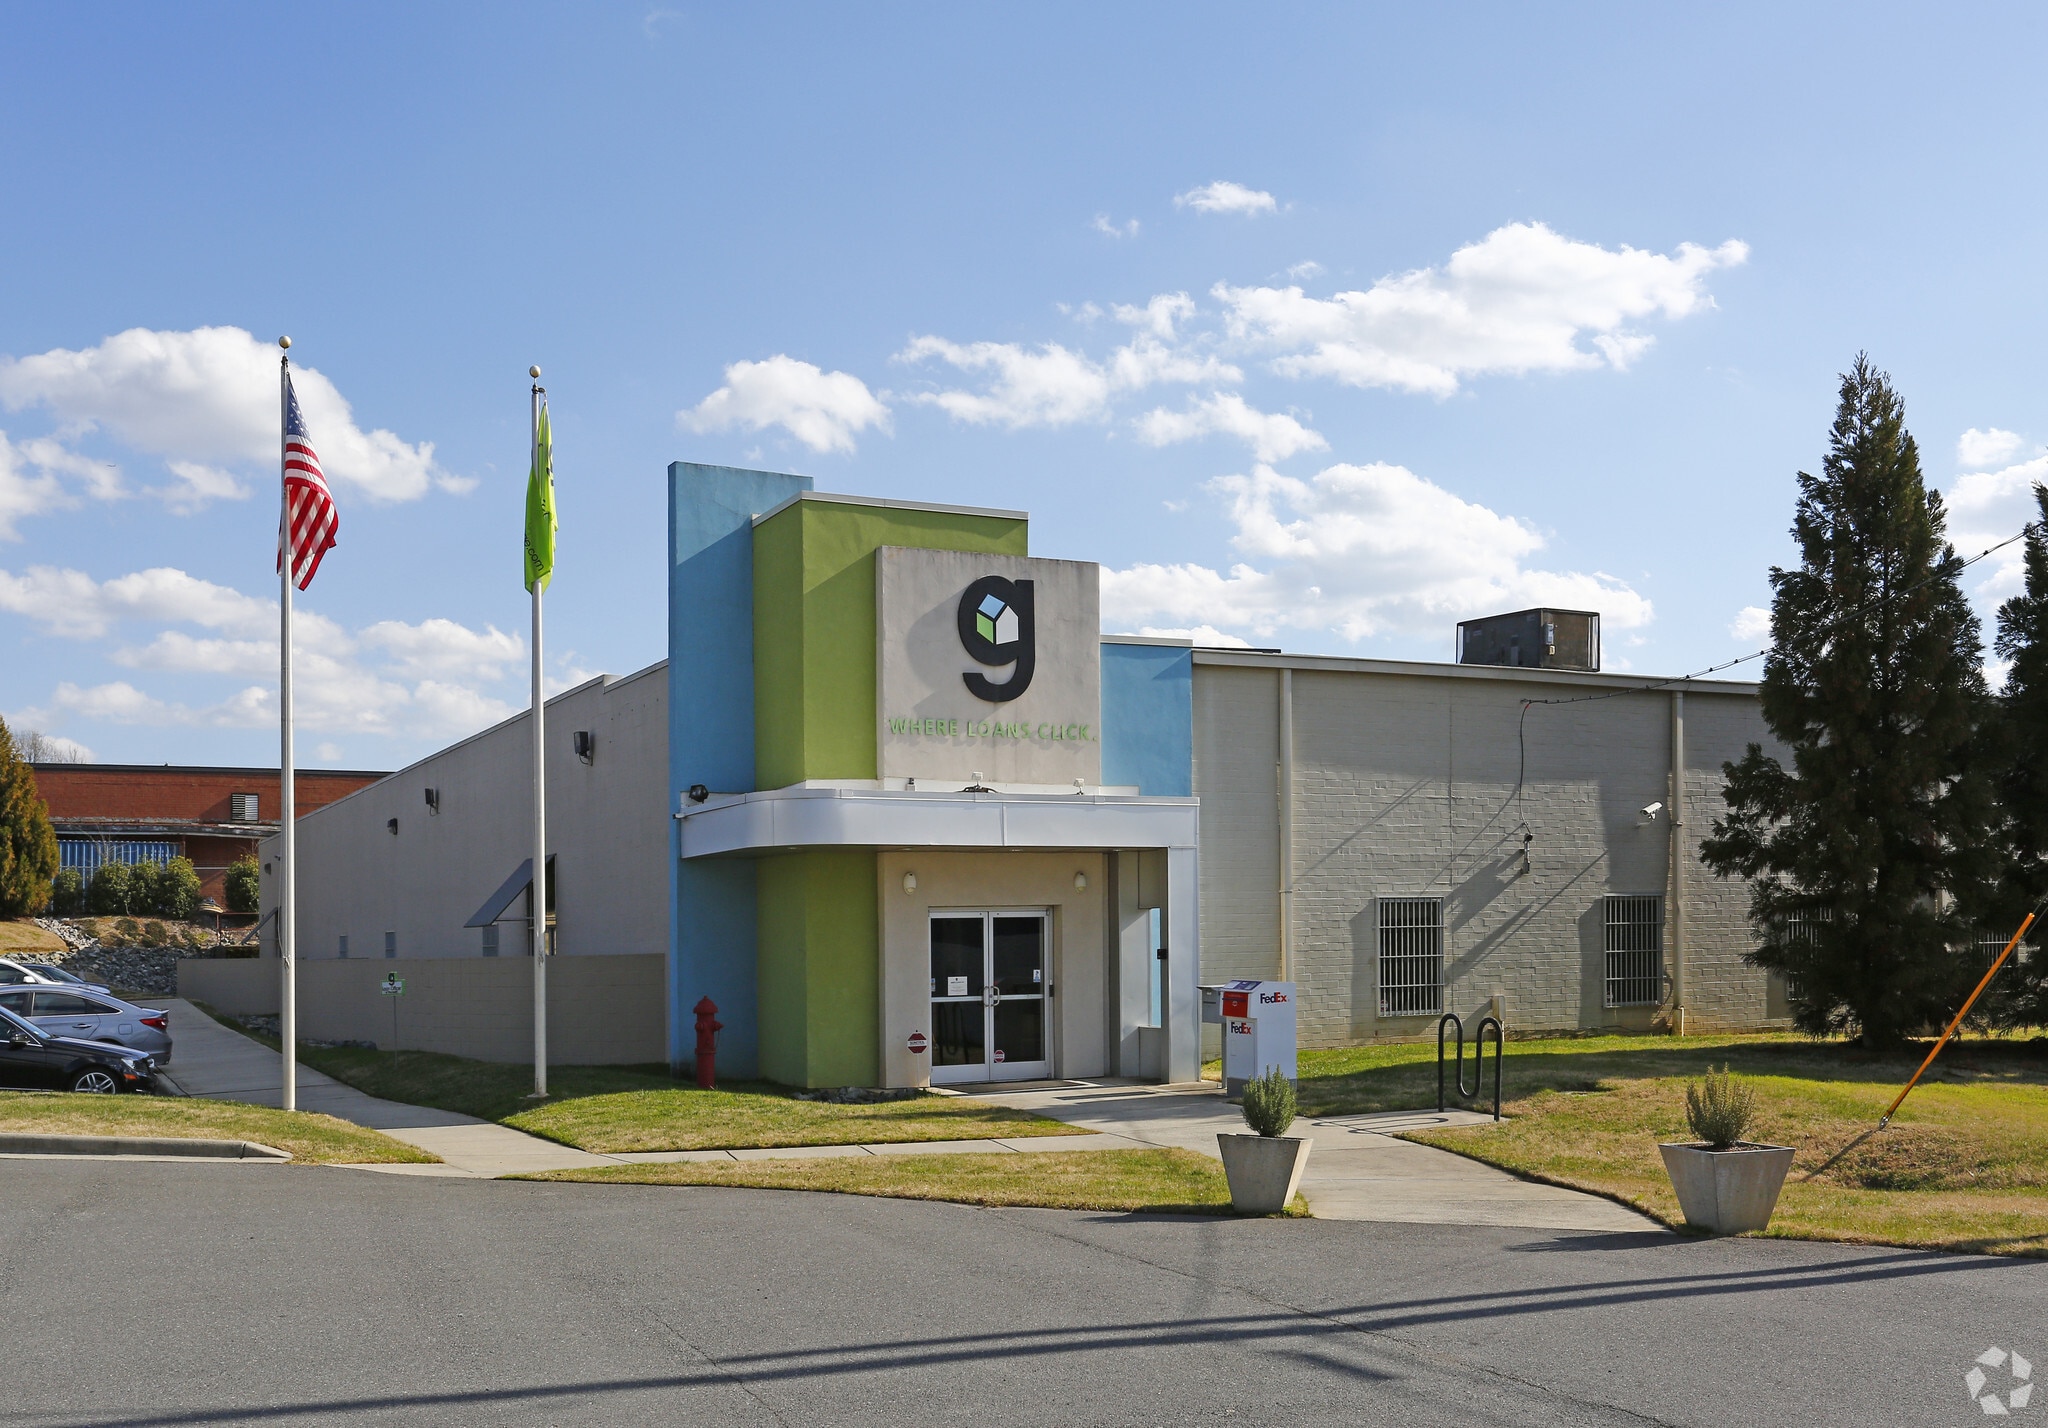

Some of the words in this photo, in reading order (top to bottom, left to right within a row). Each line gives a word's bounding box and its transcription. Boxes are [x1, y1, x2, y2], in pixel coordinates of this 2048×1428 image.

[524, 534, 545, 572] e.com
[957, 575, 1036, 703] g
[889, 718, 958, 737] WHERE
[966, 720, 1031, 739] LOANS
[1038, 722, 1098, 741] CLICK.
[1260, 992, 1287, 1004] FedEx
[1230, 1021, 1252, 1035] FedEx
